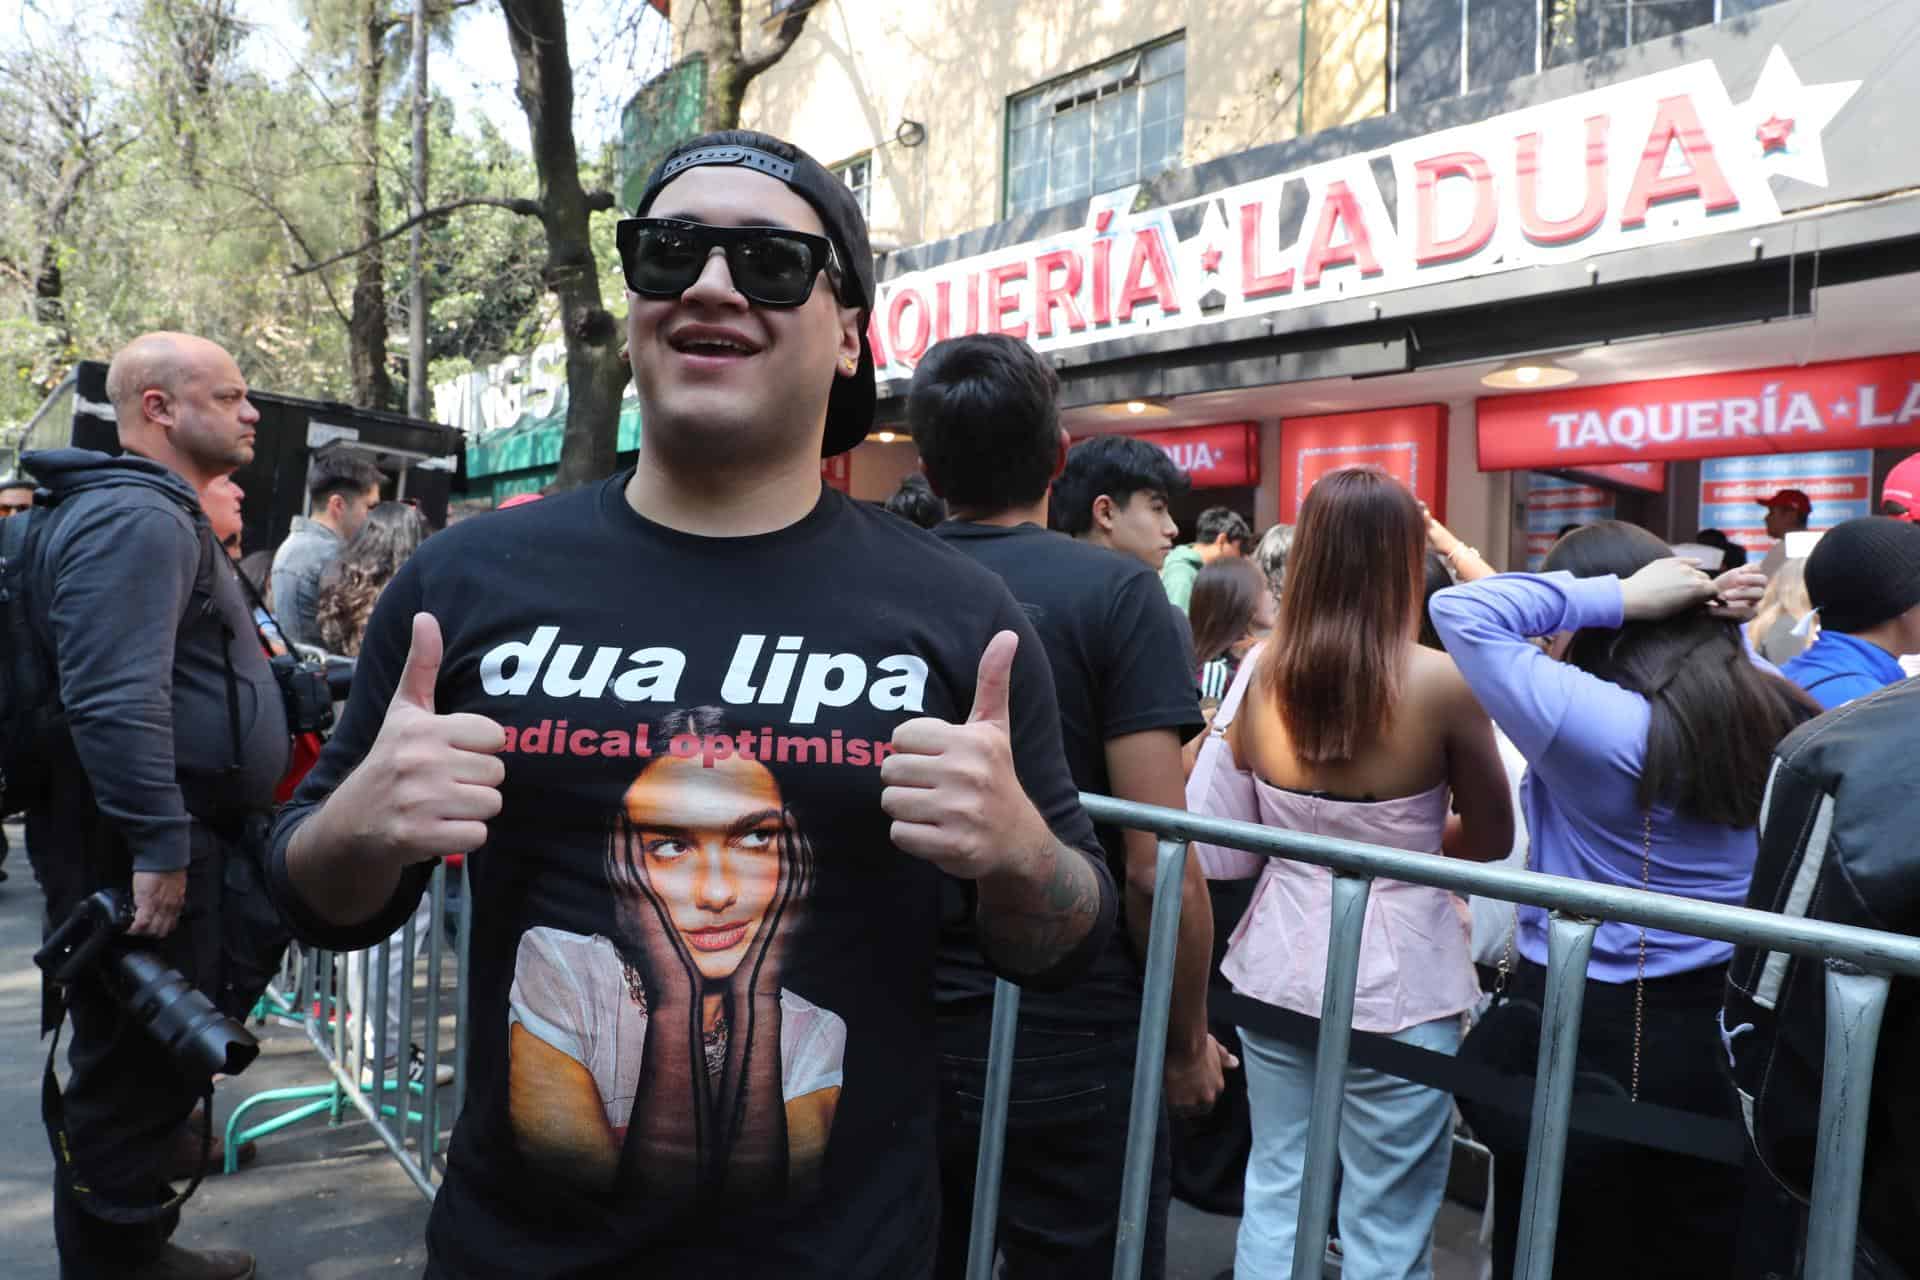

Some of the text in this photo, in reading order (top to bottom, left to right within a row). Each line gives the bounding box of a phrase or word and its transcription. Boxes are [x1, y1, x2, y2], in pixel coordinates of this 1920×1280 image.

[1240, 180, 1383, 298] LA
[1414, 94, 1739, 266] DUA
[1548, 380, 1827, 450] TAQUERÍA
[479, 625, 930, 725] dua lipa
